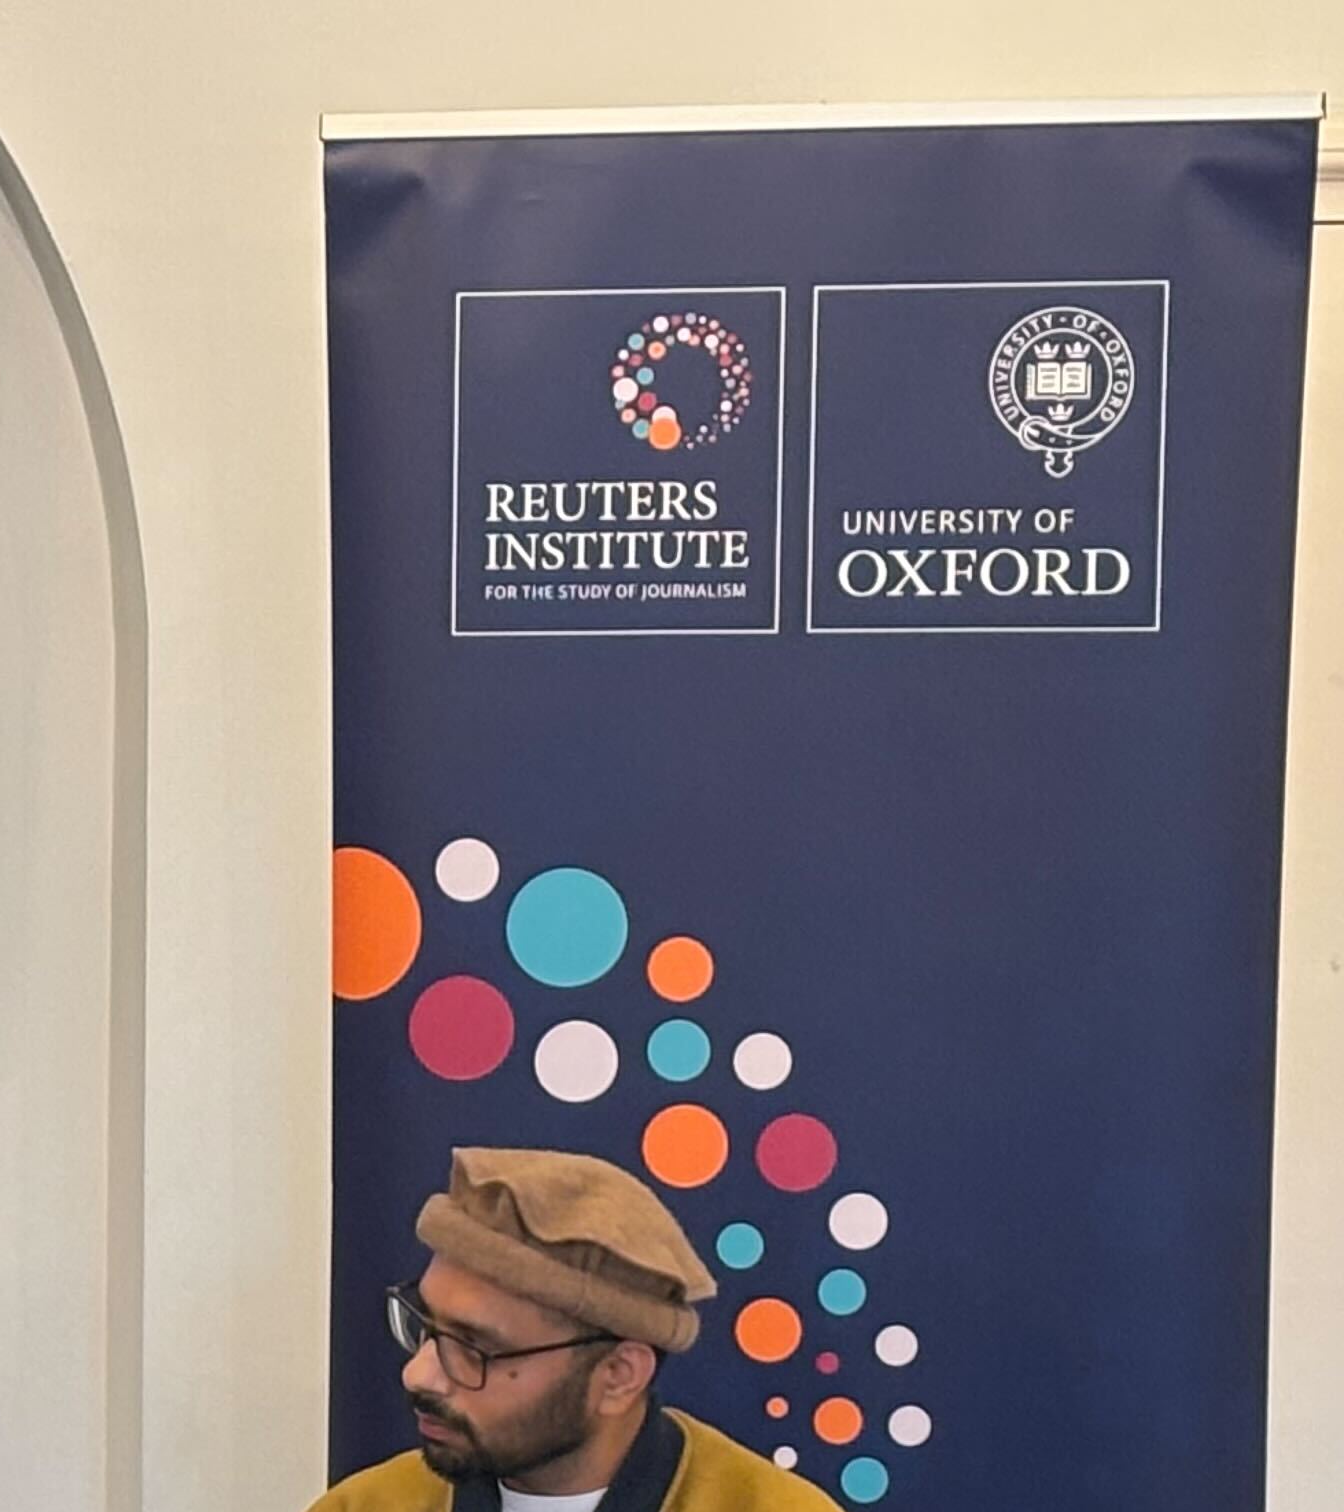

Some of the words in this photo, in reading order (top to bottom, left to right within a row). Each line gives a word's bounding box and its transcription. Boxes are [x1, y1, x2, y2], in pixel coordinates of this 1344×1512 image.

[994, 313, 1054, 423] UNIVERSITY
[1072, 314, 1101, 334] OF
[1100, 337, 1129, 423] OXFORD
[485, 480, 718, 522] REUTERS
[843, 508, 1023, 535] UNIVERSITY
[1033, 508, 1075, 533] OF
[484, 530, 750, 571] INSTITUTE
[484, 584, 518, 600] FOR
[521, 584, 554, 600] THE
[558, 584, 611, 600] STUDY
[616, 583, 637, 598] OF
[640, 582, 747, 601] JOURNALISM
[838, 548, 1131, 597] OXFORD
